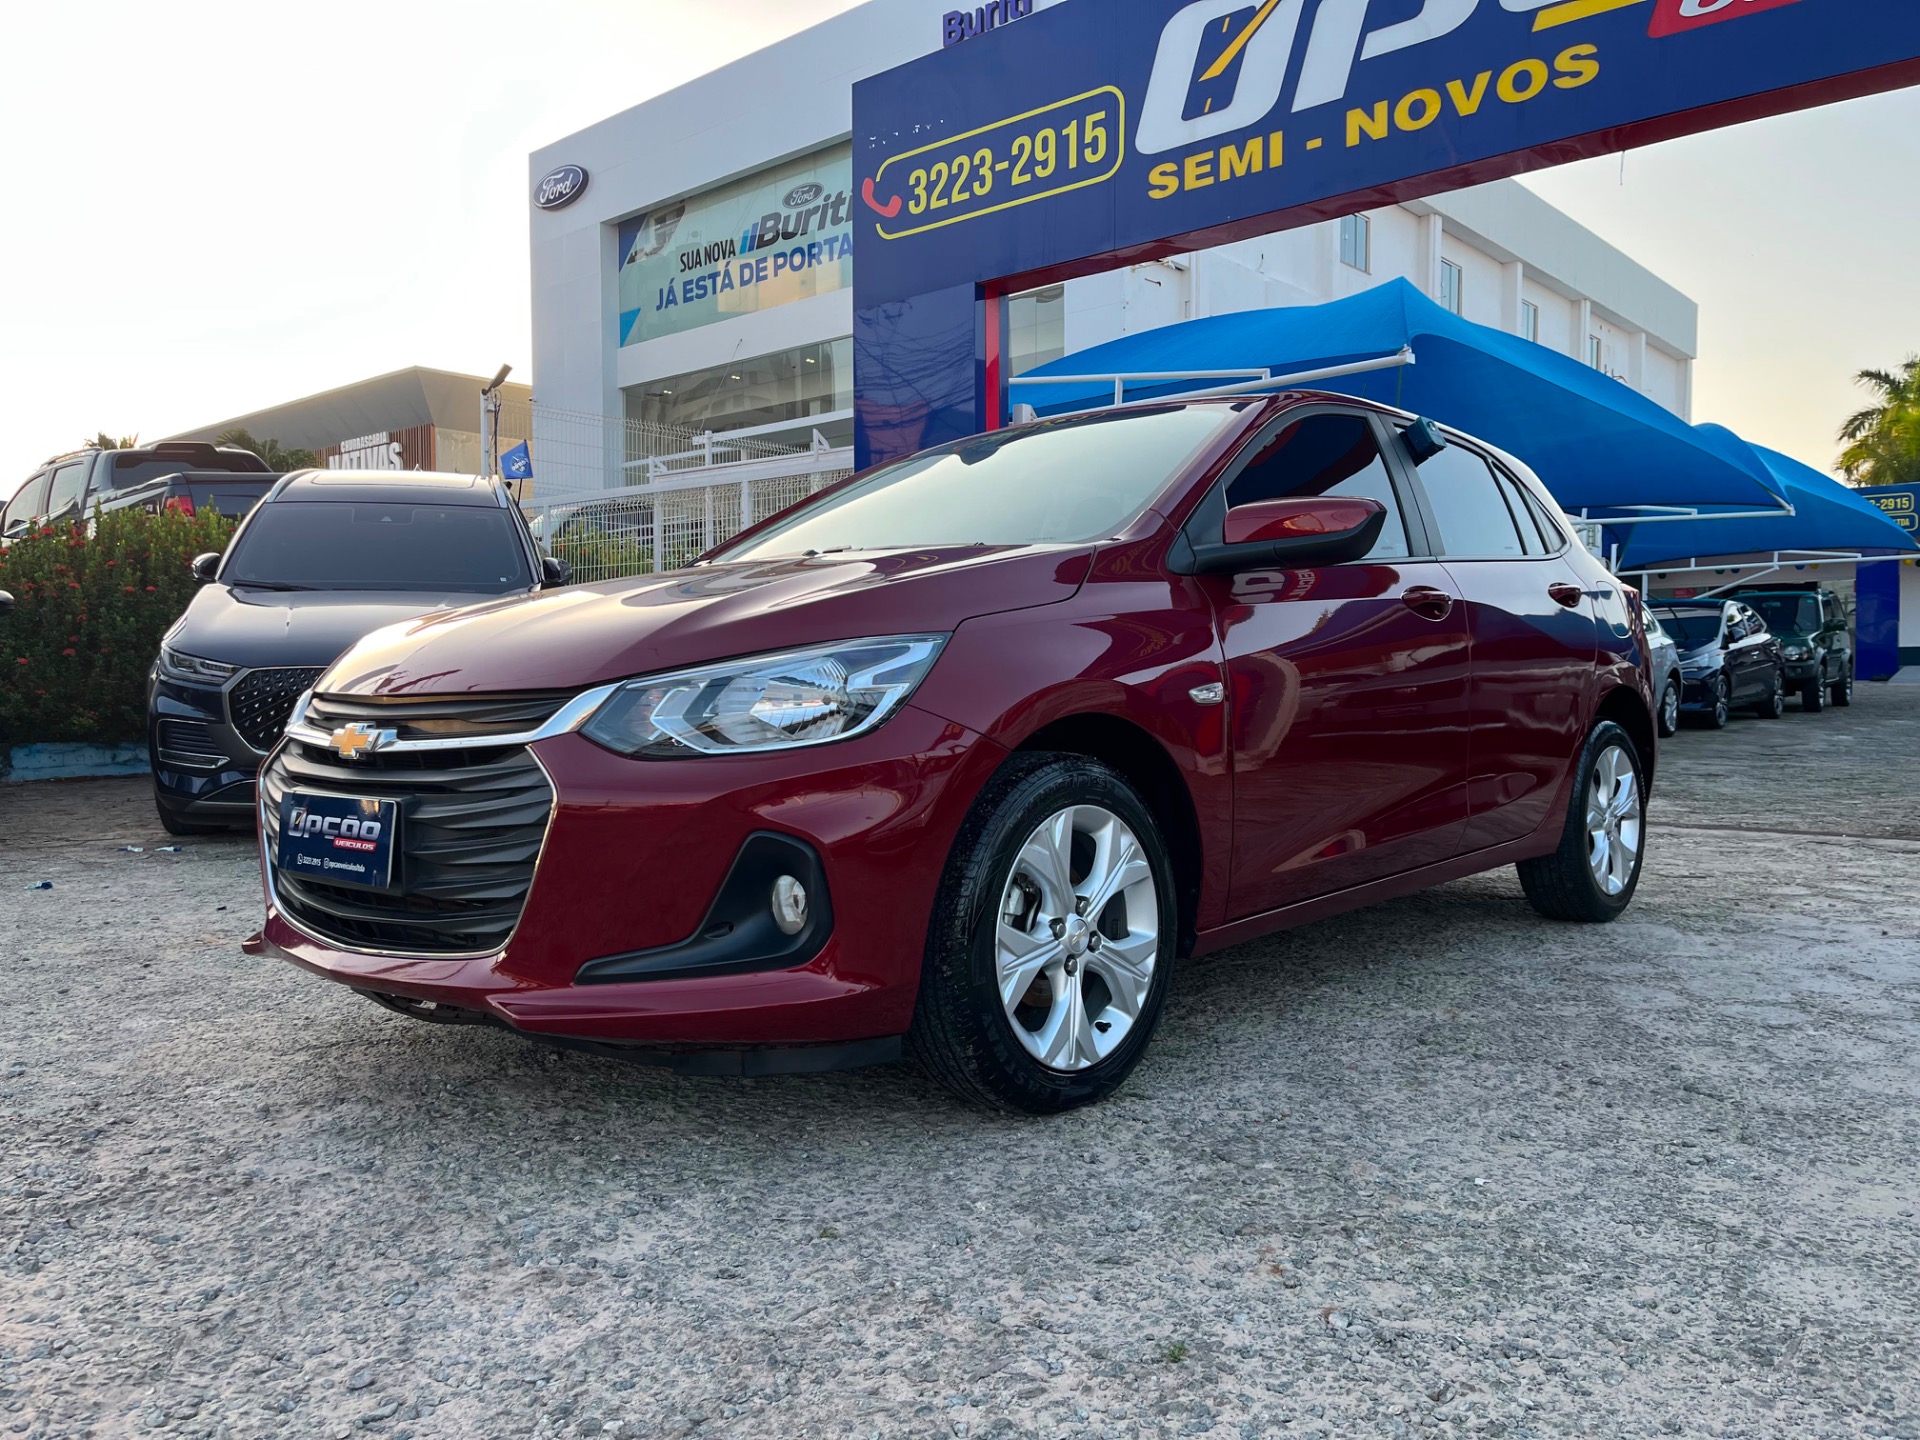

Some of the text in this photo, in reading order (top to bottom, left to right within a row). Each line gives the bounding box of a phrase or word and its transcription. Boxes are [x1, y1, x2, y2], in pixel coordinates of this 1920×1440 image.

[1148, 131, 1284, 200] SEMI
[1345, 43, 1600, 148] NOVOS
[908, 111, 1106, 215] 3223-2915
[539, 173, 574, 204] Ford
[789, 185, 816, 206] Ford
[680, 248, 703, 273] SUA
[703, 238, 736, 268] NOVA
[656, 278, 678, 311] JÁ
[683, 260, 734, 303] ESTÁ
[739, 257, 768, 287] DE
[328, 441, 404, 470] NATIVAS
[335, 840, 374, 850] VEICULOS
